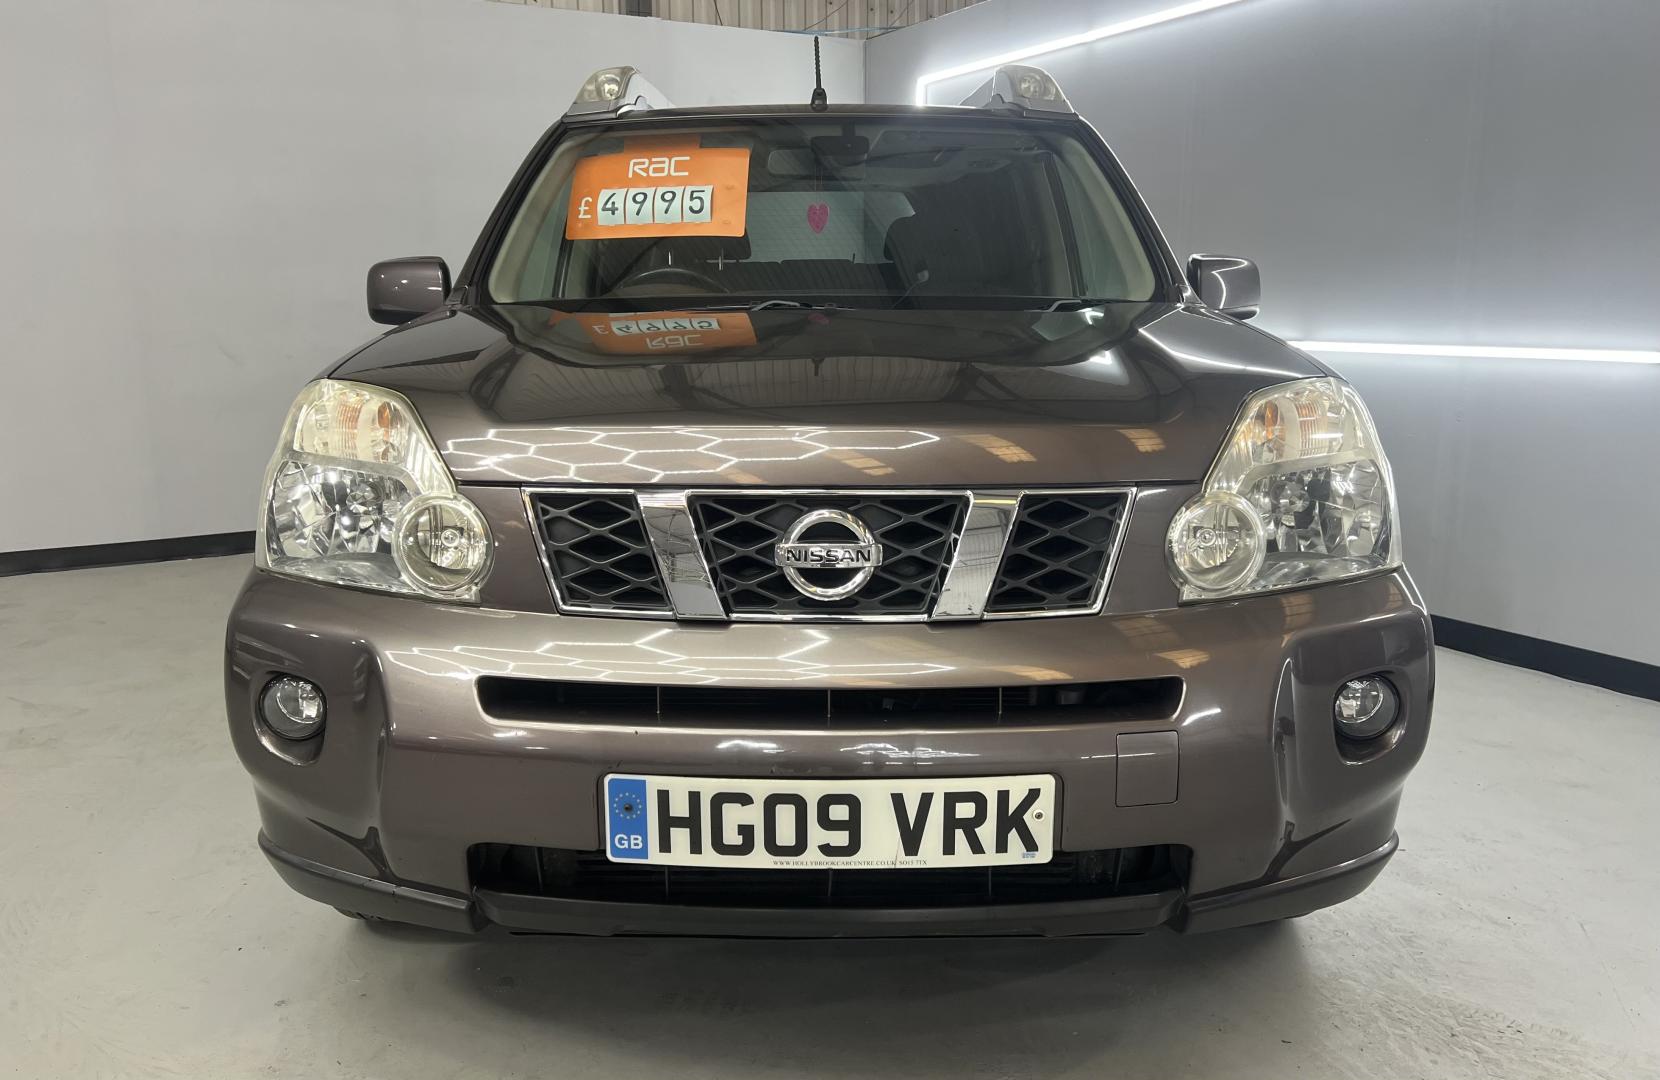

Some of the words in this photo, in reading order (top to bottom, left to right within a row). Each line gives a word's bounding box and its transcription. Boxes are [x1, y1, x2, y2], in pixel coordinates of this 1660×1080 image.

[786, 549, 871, 563] NISSAN
[656, 789, 862, 857] HG09
[889, 788, 1041, 857] VRK
[614, 834, 643, 849] GB
